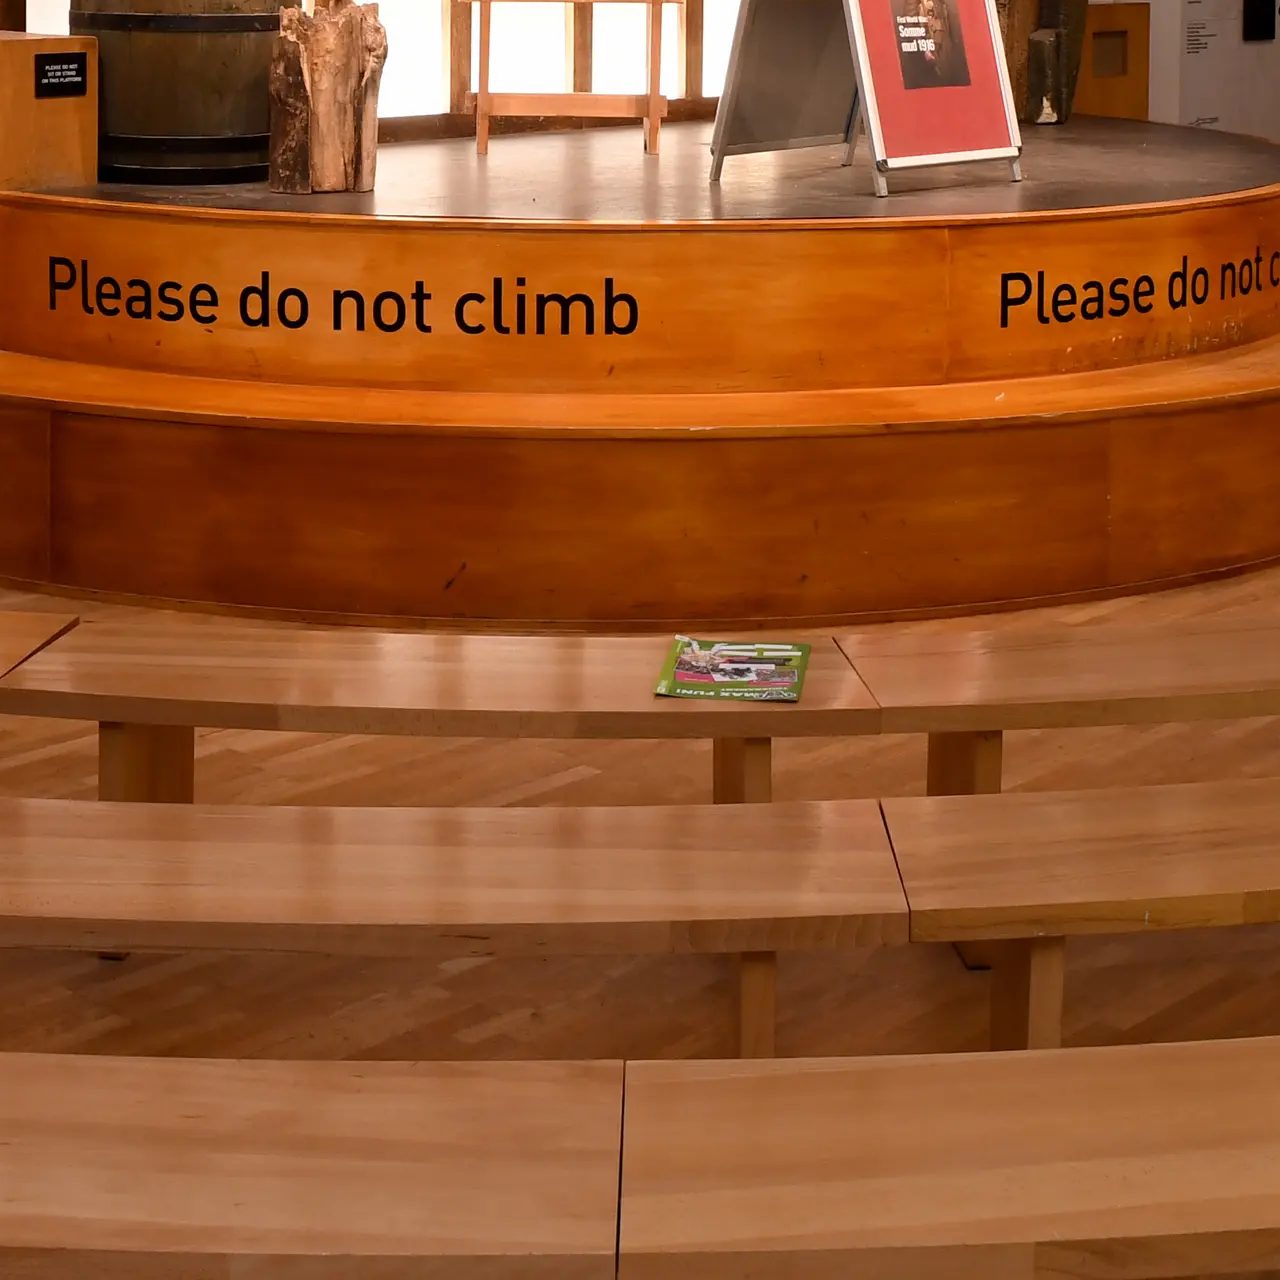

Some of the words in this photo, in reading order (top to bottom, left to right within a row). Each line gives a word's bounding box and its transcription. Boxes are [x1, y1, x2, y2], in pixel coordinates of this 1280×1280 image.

[899, 25, 926, 37] Somme
[918, 39, 935, 52] 1916
[48, 255, 219, 325] Please
[238, 270, 309, 330] do
[333, 280, 432, 334] not
[454, 276, 639, 336] climb
[1000, 270, 1155, 329] Please
[1168, 255, 1210, 311] do
[1220, 246, 1263, 302] not
